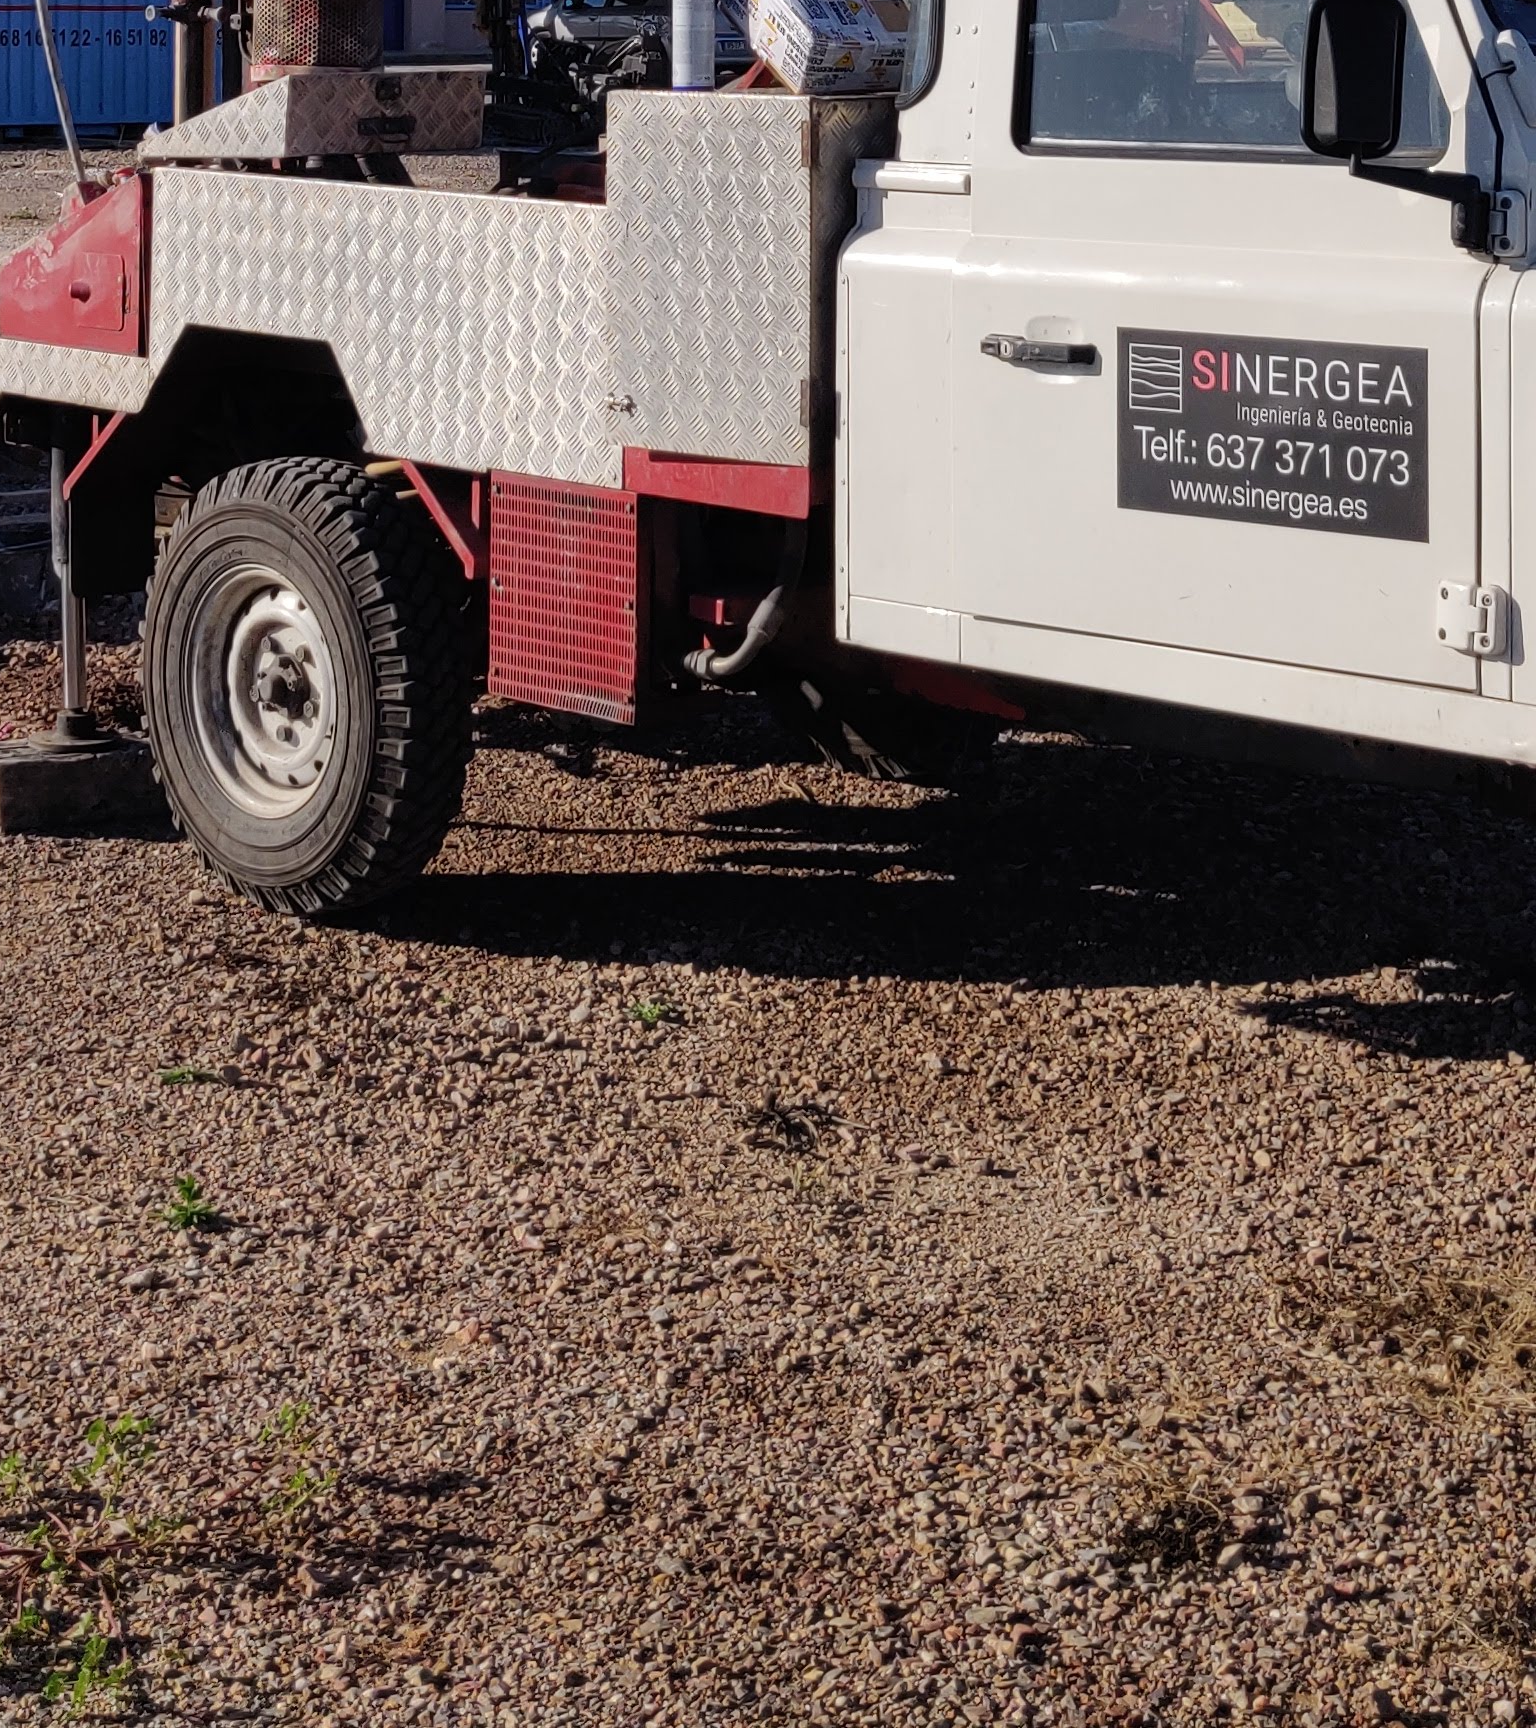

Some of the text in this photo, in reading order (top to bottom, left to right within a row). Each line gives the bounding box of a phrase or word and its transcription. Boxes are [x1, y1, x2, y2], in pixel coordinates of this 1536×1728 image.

[70, 28, 91, 47] 22
[106, 28, 123, 46] 16
[127, 28, 143, 46] 51
[149, 28, 167, 47] 82
[1191, 349, 1413, 408] SINERGEA
[1236, 402, 1413, 436] Ingeniería & Geotecnia
[1133, 424, 1410, 486] Telf.: 637 371 073
[1170, 478, 1368, 521] www.sinergea.es
